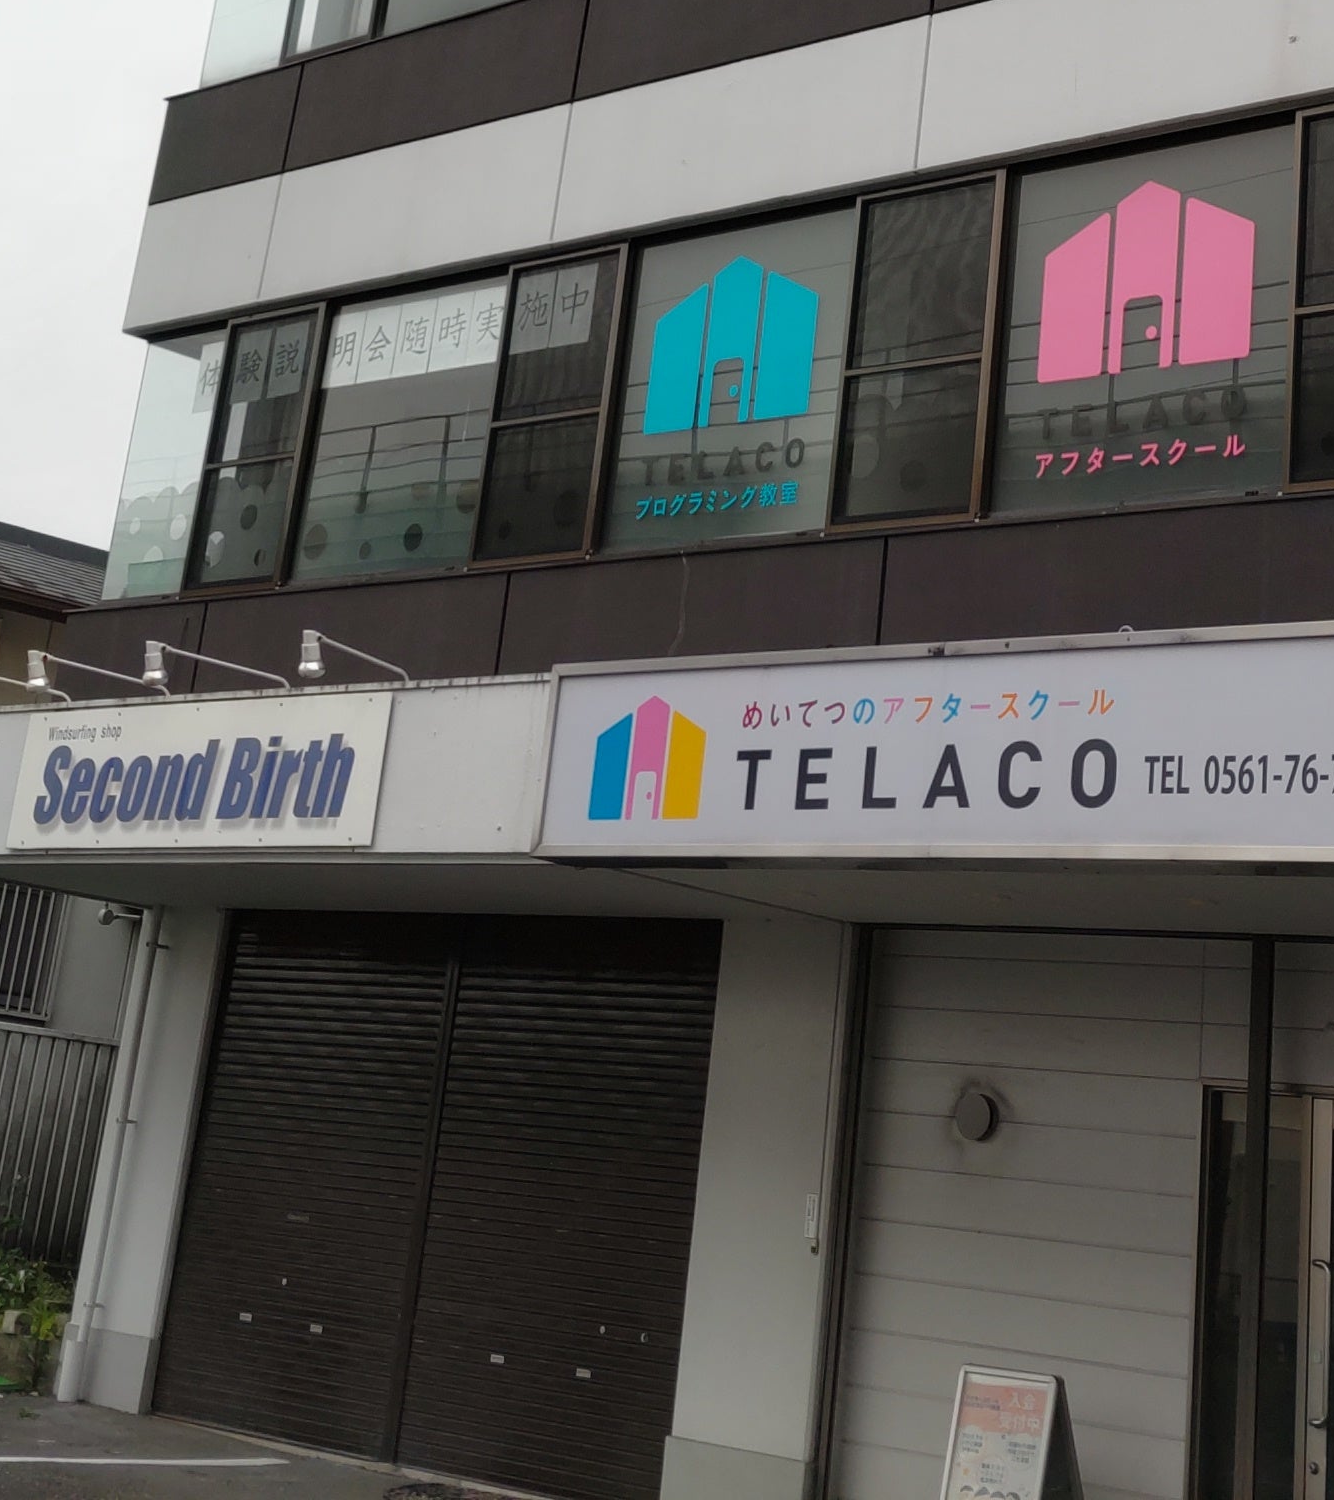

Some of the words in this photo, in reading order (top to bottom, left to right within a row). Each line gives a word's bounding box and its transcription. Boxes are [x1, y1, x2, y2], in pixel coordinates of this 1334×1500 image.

[641, 437, 805, 486] TELACO
[1034, 433, 1247, 480] アフタースクール
[635, 480, 799, 520] プログラミング教室
[740, 687, 1115, 731] めいてつのアフタースクール
[48, 724, 97, 743] Windsurfing
[100, 723, 122, 741] shop
[33, 738, 221, 826] Second
[214, 732, 355, 821] Birth
[736, 738, 1117, 813] TELACO
[1144, 754, 1190, 796] TEL
